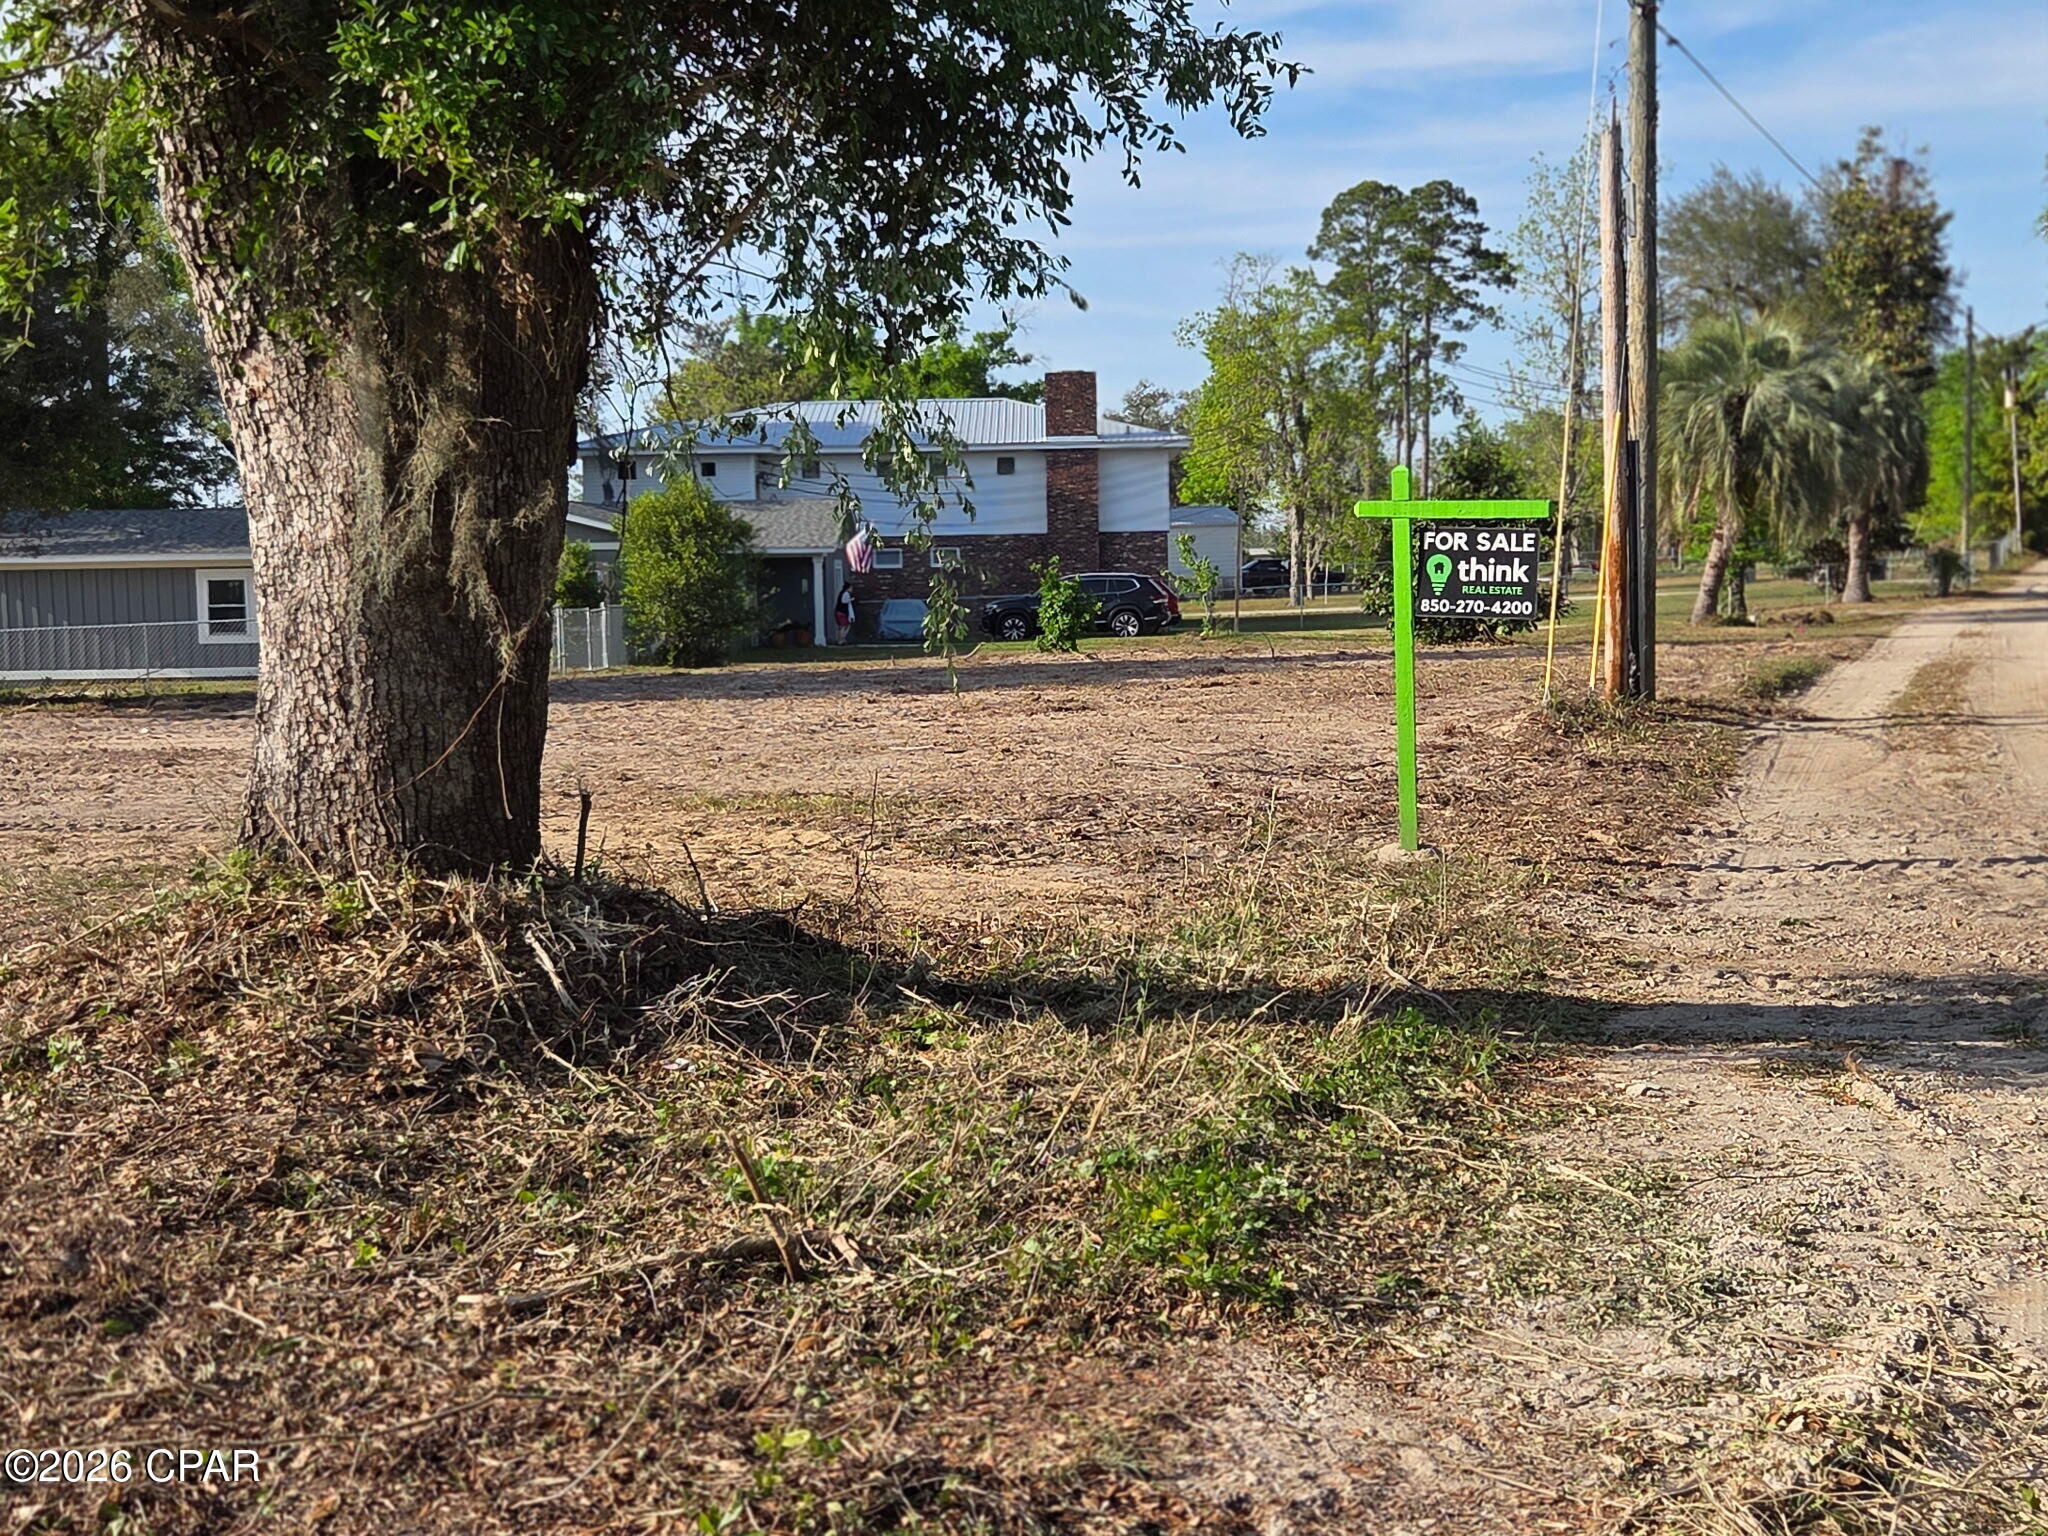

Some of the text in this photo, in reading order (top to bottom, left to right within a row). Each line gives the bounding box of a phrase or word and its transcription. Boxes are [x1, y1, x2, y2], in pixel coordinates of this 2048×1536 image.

[1423, 532, 1536, 552] FOR SALE
[1457, 556, 1530, 583] think
[1462, 586, 1523, 595] REAL ESTATE
[1420, 599, 1533, 615] 850-270-4200
